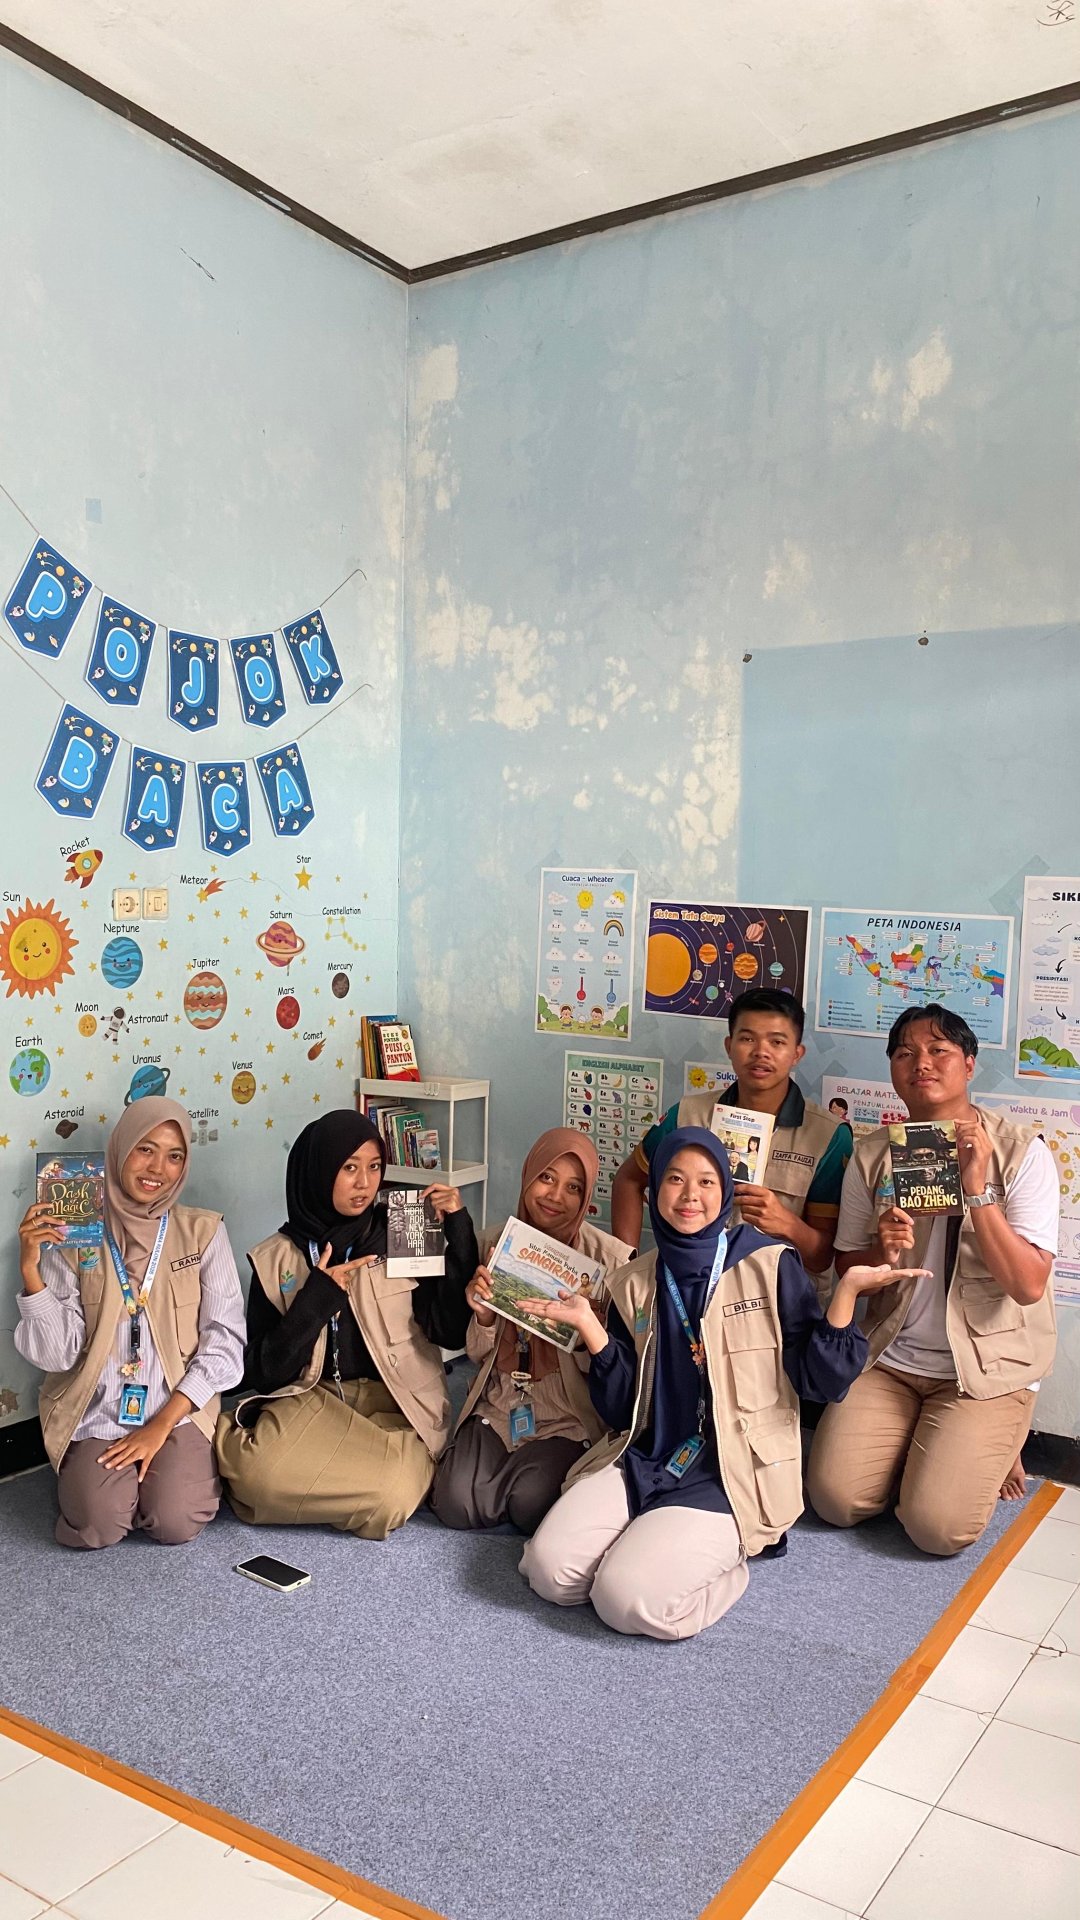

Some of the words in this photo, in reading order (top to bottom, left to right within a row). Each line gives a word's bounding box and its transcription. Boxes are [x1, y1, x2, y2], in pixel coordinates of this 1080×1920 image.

[26, 571, 331, 706] POJOK
[58, 736, 305, 831] BACA
[59, 836, 91, 857] Rocket
[296, 855, 312, 864] Star
[180, 874, 208, 884] Meteor
[2, 892, 21, 902] Sun
[270, 910, 293, 919] Saturn
[322, 906, 361, 916] Constellation
[654, 910, 679, 920] Sistem
[681, 910, 699, 921] Tata
[700, 912, 726, 926] Surya
[103, 923, 140, 935] Neptune
[867, 918, 893, 928] PETA
[898, 920, 961, 931] INDONESIA
[192, 958, 220, 970] Jupiter
[328, 962, 353, 971] Mercury
[278, 987, 294, 996] Mars
[75, 1002, 99, 1012] Moon
[127, 1013, 169, 1024] Astronaut
[302, 1031, 323, 1040] Comet
[15, 1035, 42, 1048] Earth
[385, 1042, 403, 1052] PUISI
[132, 1054, 161, 1065] Uranus
[387, 1052, 412, 1063] PANTUN
[232, 1061, 253, 1070] Venus
[837, 1086, 871, 1096] BELAJAR
[854, 1100, 906, 1111] PENJUMLAHAN
[1010, 1105, 1038, 1114] Waktu
[1051, 1109, 1068, 1117] Jam
[44, 1106, 85, 1120] Asteroid
[50, 1182, 91, 1200] Dash
[910, 1185, 944, 1196] PEDANG
[900, 1195, 922, 1208] BAO
[924, 1194, 958, 1207] ZHENG
[409, 1223, 424, 1232] NEW
[406, 1232, 424, 1240] YORK
[408, 1240, 424, 1248] HARI
[415, 1248, 424, 1256] INI
[517, 1248, 578, 1288] SANGIRAN
[564, 1260, 578, 1275] Purba
[734, 1301, 761, 1313] BILBI
